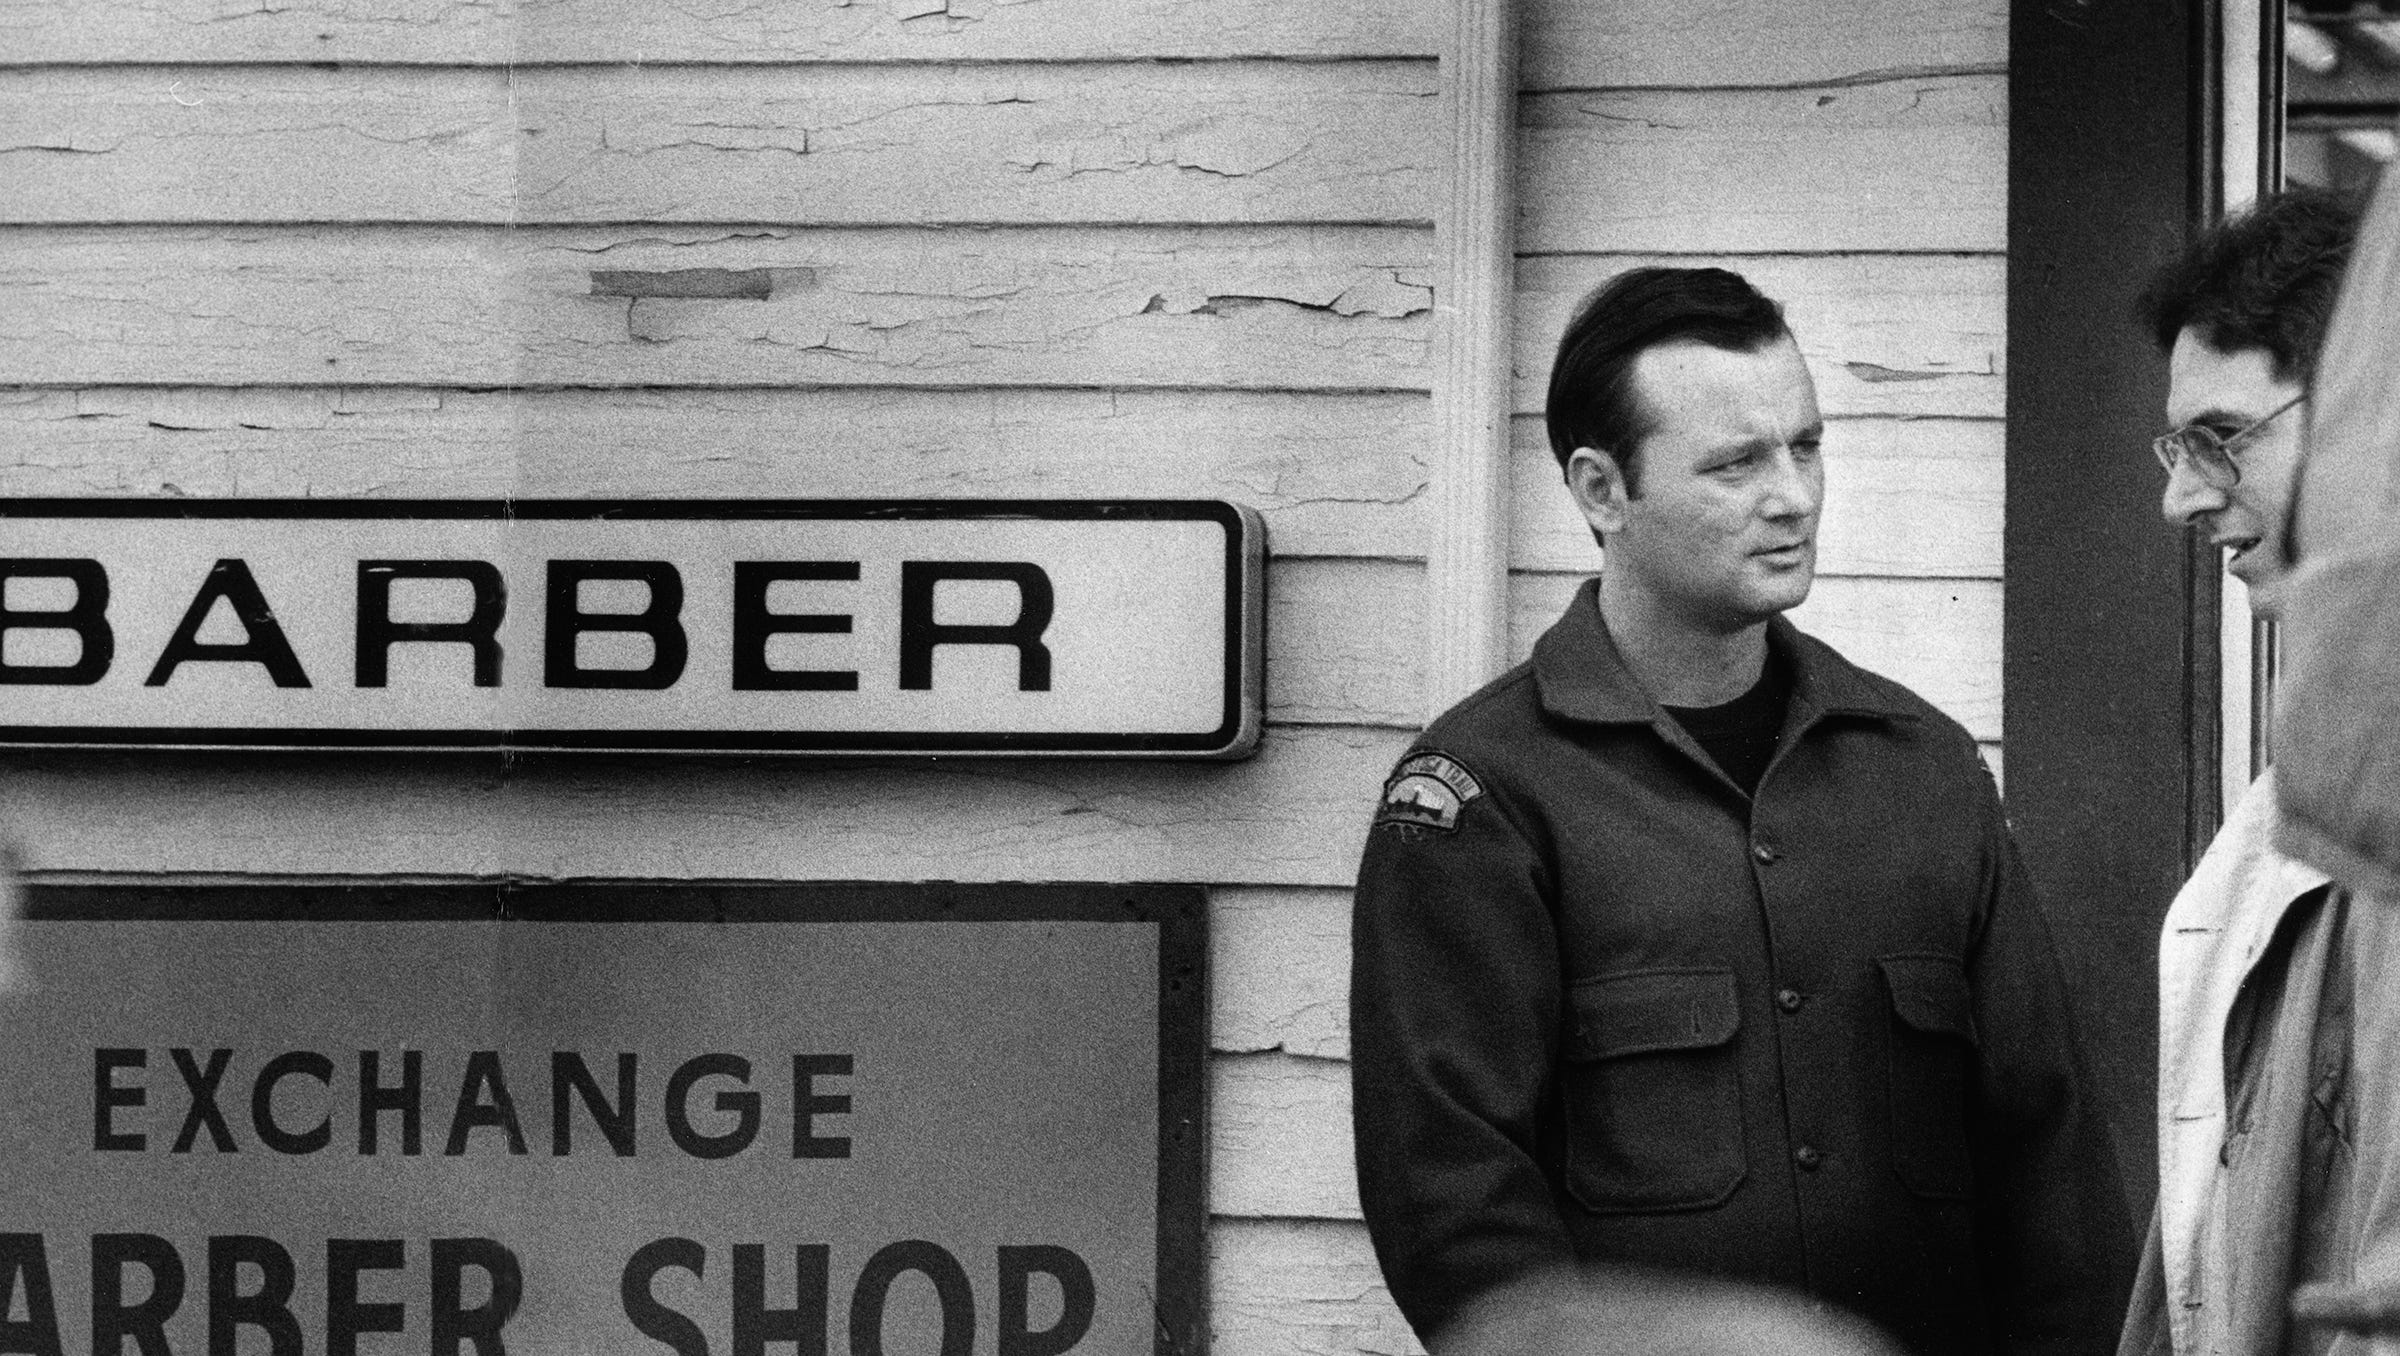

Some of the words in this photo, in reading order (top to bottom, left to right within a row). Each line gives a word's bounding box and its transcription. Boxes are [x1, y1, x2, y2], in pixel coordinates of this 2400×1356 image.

[0, 557, 1055, 692] BARBER
[93, 1047, 854, 1160] EXCHANGE
[620, 1236, 1096, 1356] SHOP
